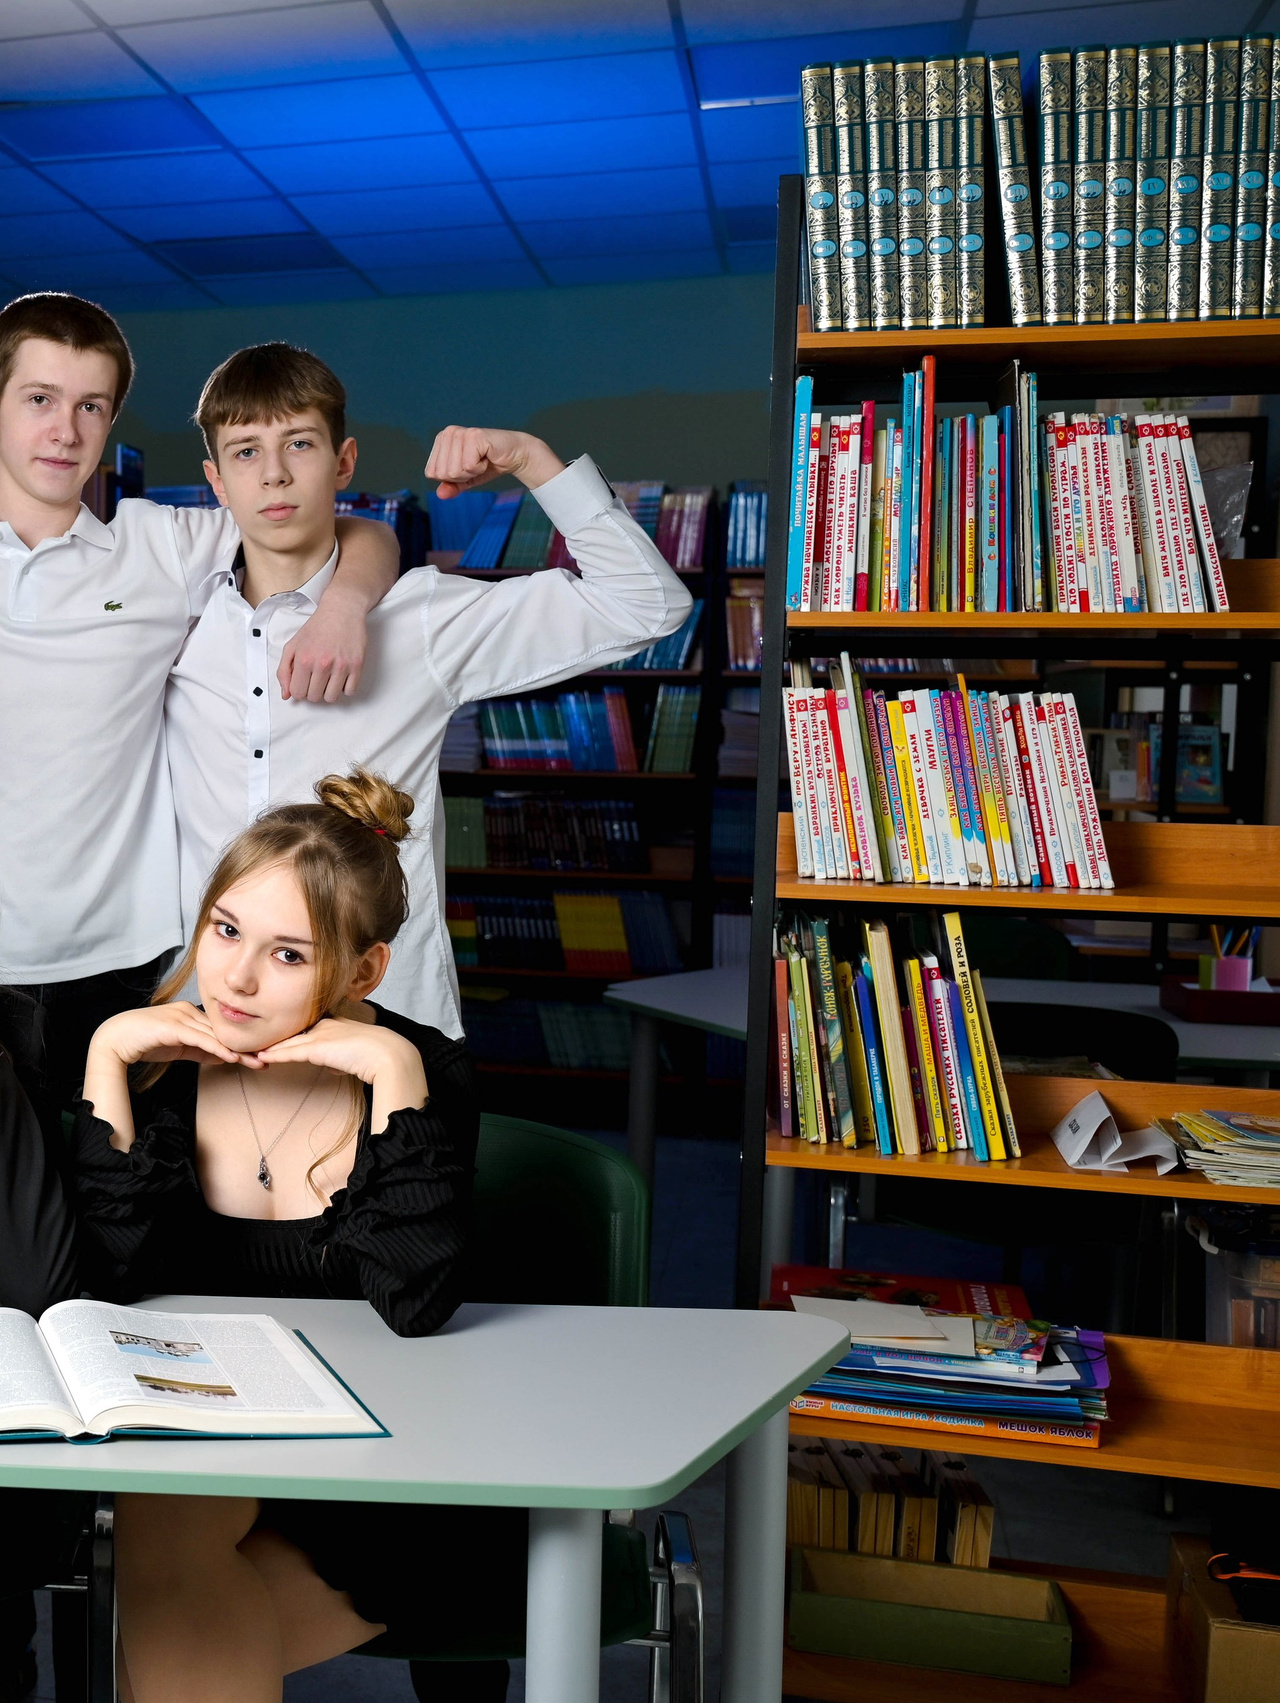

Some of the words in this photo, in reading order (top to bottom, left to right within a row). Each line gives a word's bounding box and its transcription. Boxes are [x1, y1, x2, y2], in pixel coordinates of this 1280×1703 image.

[797, 413, 807, 465] МАЛЫШАМ
[1146, 442, 1156, 466] ДОМА
[849, 470, 857, 498] КАША
[1048, 445, 1058, 502] КУРОЛЕСОВА
[1071, 465, 1080, 496] ДРУЗЬЯ
[1081, 447, 1091, 496] РАССКАЗЫ
[1101, 442, 1111, 496] ДВИЖЕНИЯ
[1125, 458, 1134, 490] СЛОВО
[1131, 454, 1141, 481] СВЕТЕ
[1151, 478, 1161, 508] ШКОЛЕ
[1174, 459, 1190, 515] ИНТЕРЕСНО!
[1052, 506, 1060, 530] ВАСИ
[1097, 494, 1108, 547] ШКОЛЬНЫЕ
[1168, 498, 1176, 513] ЭТО
[1199, 504, 1211, 539] ЧТЕНИЕ
[804, 510, 814, 563] НАЧИНАЕТСЯ
[824, 508, 834, 564] МОСКВИЧЕВ
[847, 502, 856, 553] МИШКИНА
[988, 503, 996, 546] КОШКИН
[1063, 513, 1072, 541] ГОСТИ
[1085, 500, 1096, 557] ДЕНИСКИНЫ
[1106, 499, 1118, 556] ДОРОЖНОГО
[1129, 495, 1141, 555] ВОЛШЕБНОЕ
[1141, 521, 1150, 540] ПРО
[1156, 519, 1167, 552] МАЛЕЕВ
[1170, 516, 1179, 531] ГДЕ
[1183, 518, 1192, 534] ЧТО
[967, 518, 975, 573] Владимир
[1075, 526, 1086, 565] ДЕНИСКА
[1186, 538, 1195, 555] ВОТ
[1055, 535, 1066, 603] ПРИКЛЮЧЕНИЯ
[1066, 555, 1075, 585] ХОДИТ
[1111, 561, 1123, 605] ПРАВИЛА
[1161, 555, 1170, 577] ВИТЯ
[1179, 574, 1187, 589] ЭТО
[1207, 542, 1227, 606] ВНЕКЛАССНОЕ
[802, 567, 810, 603] ДРУЖБА
[1069, 588, 1077, 605] КТО
[1181, 592, 1190, 607] ГДЕ
[788, 692, 798, 739] АНФИСУ
[809, 695, 820, 741] НЕЗНАЙКИ
[876, 698, 891, 747] ВСТРЕЧАЛИ
[932, 697, 944, 729] ДРУЗЬЯ
[943, 698, 955, 734] СПАСАЛИ
[957, 700, 968, 737] СПАСАЛИ
[982, 702, 996, 754] МЕДВЕЖАТ
[992, 700, 1003, 734] НИЛЬСА
[800, 719, 813, 768] ЧЕЛОВЕКОМ!
[820, 720, 832, 763] БУРАТИНО
[910, 734, 920, 764] ЗЕМЛИ
[924, 729, 938, 770] МАУГЛИ
[1060, 716, 1075, 768] ЧЕМОДАНЧИКА
[1069, 707, 1086, 759] ЛЕОПОЛЬДА
[793, 750, 801, 777] ВЕРУ
[814, 744, 824, 778] ОСТРОВ
[873, 751, 884, 776] ЗМЕЮ
[885, 749, 893, 766] ГОД
[949, 736, 961, 766] СКАЗКУ
[963, 737, 973, 769] СКАЗКУ
[1035, 749, 1047, 784] НЕЗНАЙКИ
[807, 770, 815, 790] БУДЬ
[942, 759, 953, 793] КОСЬКА
[1080, 761, 1090, 784] КОТА
[826, 769, 840, 833] ПРИКЛЮЧЕНИЯ
[851, 776, 862, 811] КУЗЬКА
[877, 780, 889, 816] СВОБОДУ
[917, 777, 930, 819] ДЕВОЧКА
[948, 795, 957, 818] ЗАЯЦ
[997, 797, 1007, 823] ПЯТЬ
[961, 812, 971, 828] КАК
[976, 815, 984, 831] КАК
[1077, 800, 1094, 852] ПРИКЛЮЧЕНИЯ
[1084, 787, 1100, 836] РОЖДЕНИЯ
[900, 843, 908, 860] КАК
[1088, 853, 1099, 880] НОВЫЕ
[1096, 838, 1107, 862] ДЕНЬ
[954, 935, 964, 958] РОЗА
[916, 982, 927, 1028] МЕДВЕДЬ
[959, 971, 974, 1014] СОЛОВЕЙ
[934, 998, 949, 1052] ПИСАТЕЛЕЙ
[970, 1018, 982, 1057] писателей
[925, 1031, 933, 1065] МАША
[944, 1056, 957, 1098] РУССКИХ
[979, 1061, 992, 1106] зарубежных
[784, 1100, 789, 1108] ОТ
[951, 1103, 963, 1140] СКАЗКИ
[987, 1110, 997, 1136] Сказки
[830, 1402, 899, 1418] НАСТОЛЬНАЯ
[933, 1415, 985, 1427] ХОДИЛКА
[998, 1421, 1046, 1434] МЕШОК
[1050, 1426, 1094, 1439] ЯБЛОК
